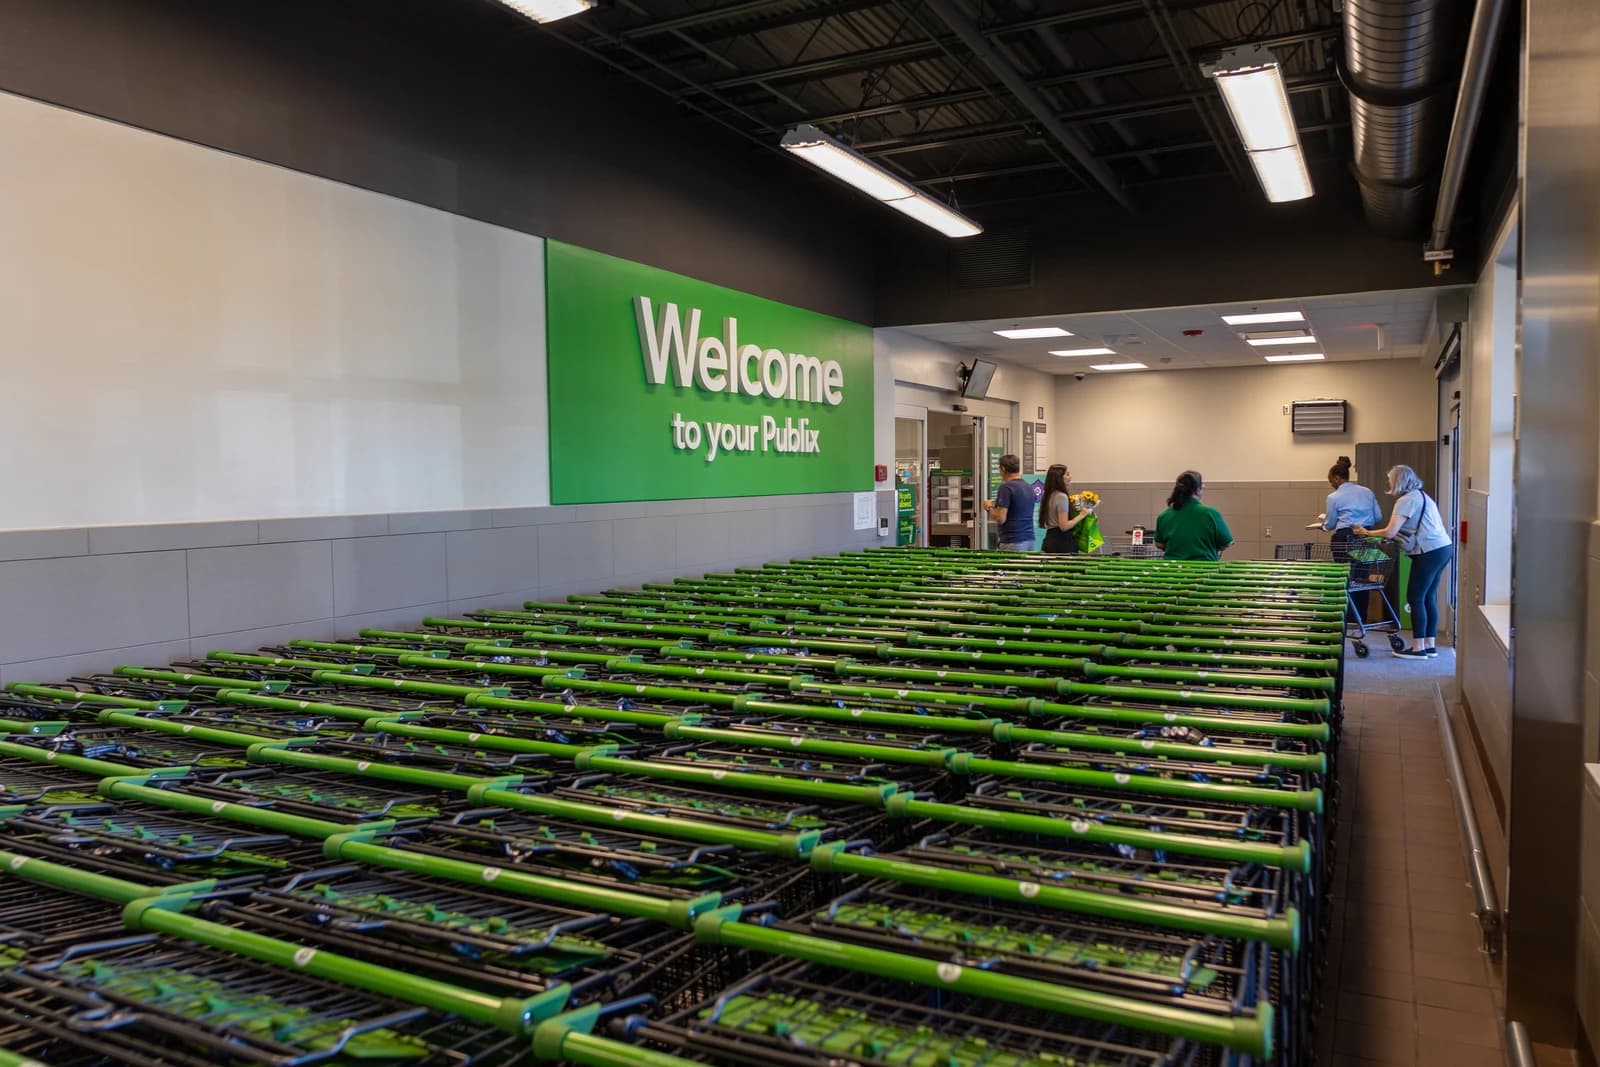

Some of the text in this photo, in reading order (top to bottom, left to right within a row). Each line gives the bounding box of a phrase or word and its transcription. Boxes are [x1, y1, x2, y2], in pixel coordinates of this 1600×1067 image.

[633, 296, 844, 405] Welcome
[672, 413, 820, 461] to your Publix
